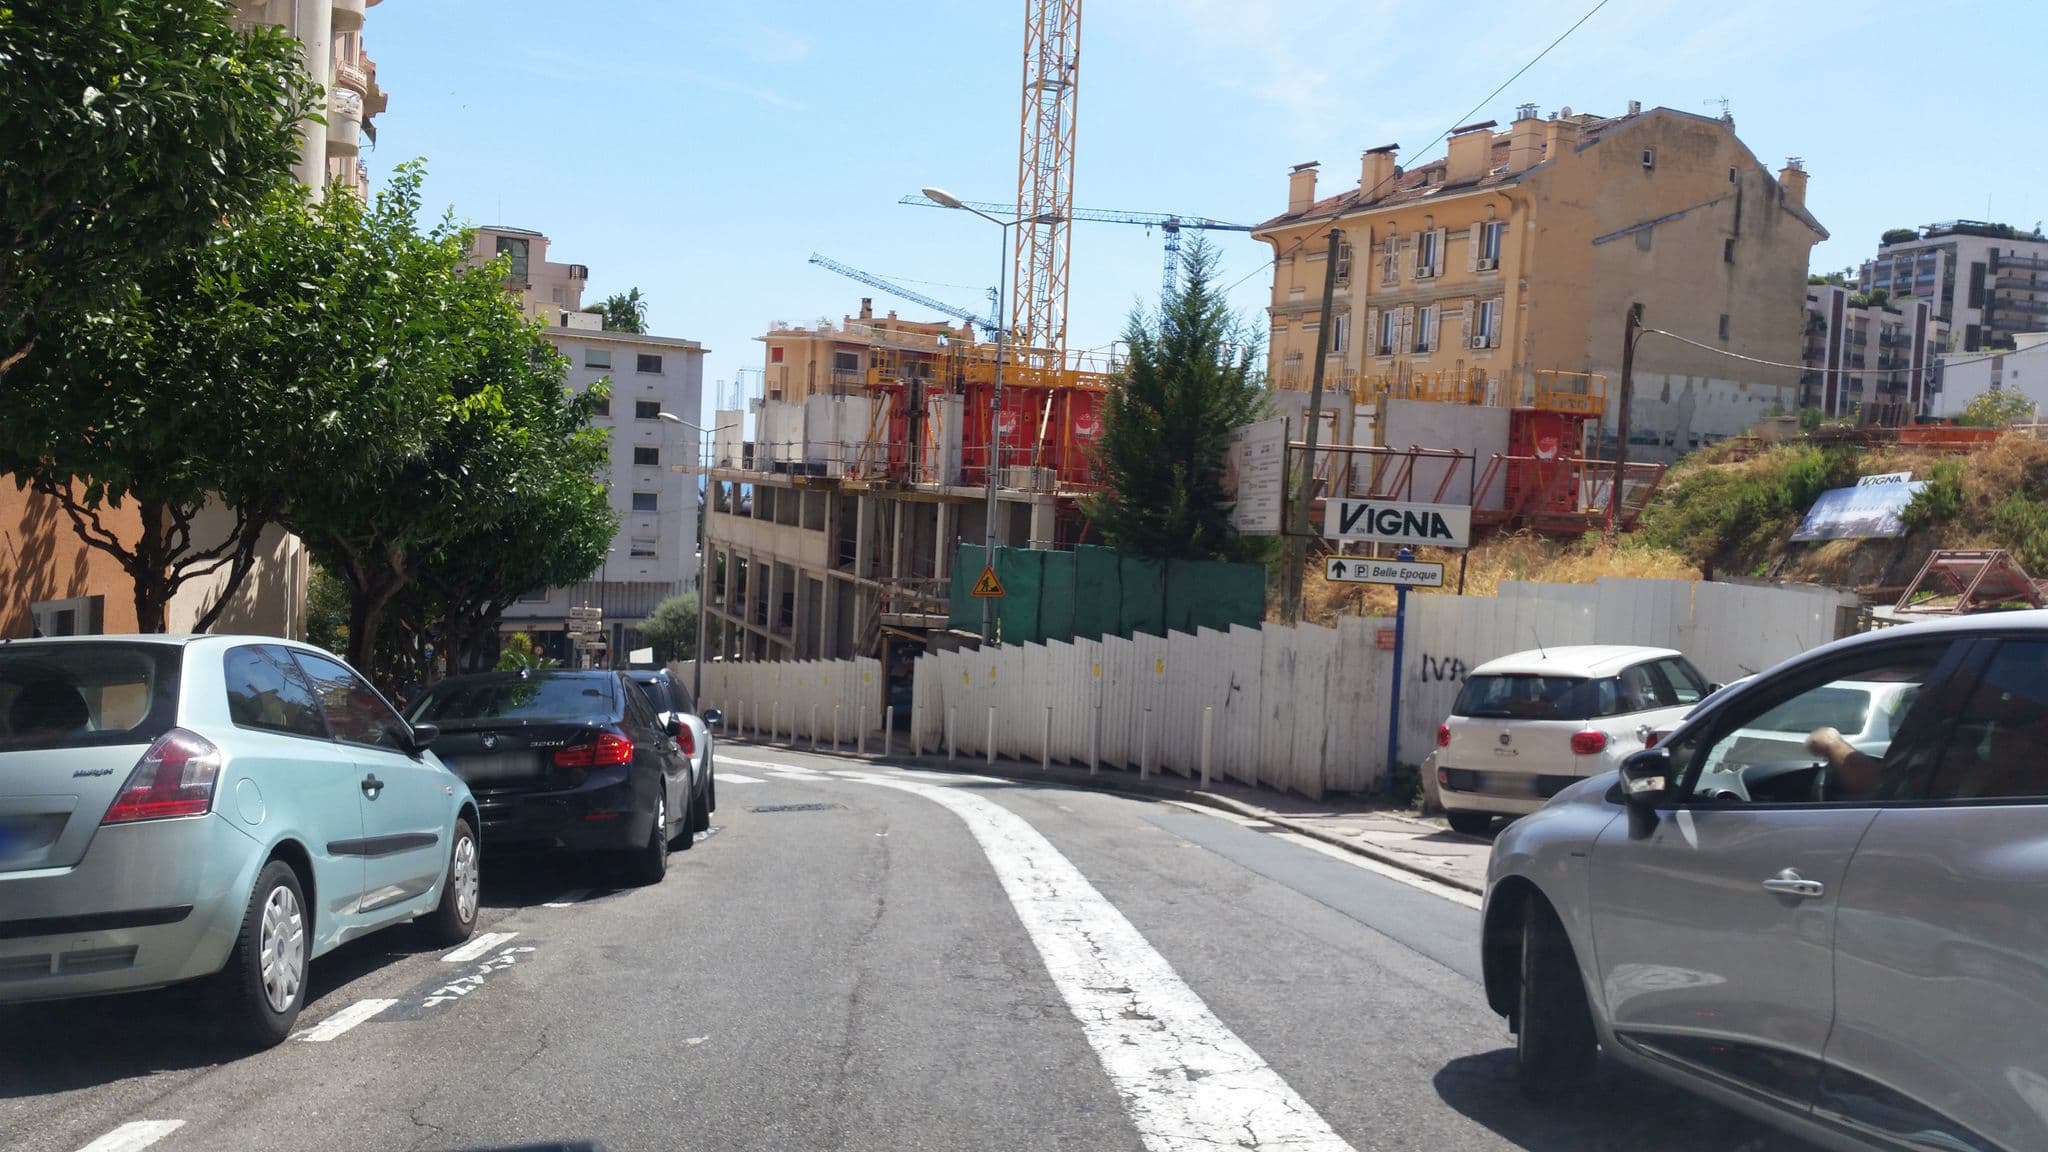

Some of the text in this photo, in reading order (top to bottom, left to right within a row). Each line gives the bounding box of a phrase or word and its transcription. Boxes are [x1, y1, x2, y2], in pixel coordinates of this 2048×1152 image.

[1862, 475, 1902, 486] VIGNA
[1339, 503, 1453, 539] VIGNA
[1372, 566, 1398, 578] Belle
[1399, 568, 1438, 581] Epoque
